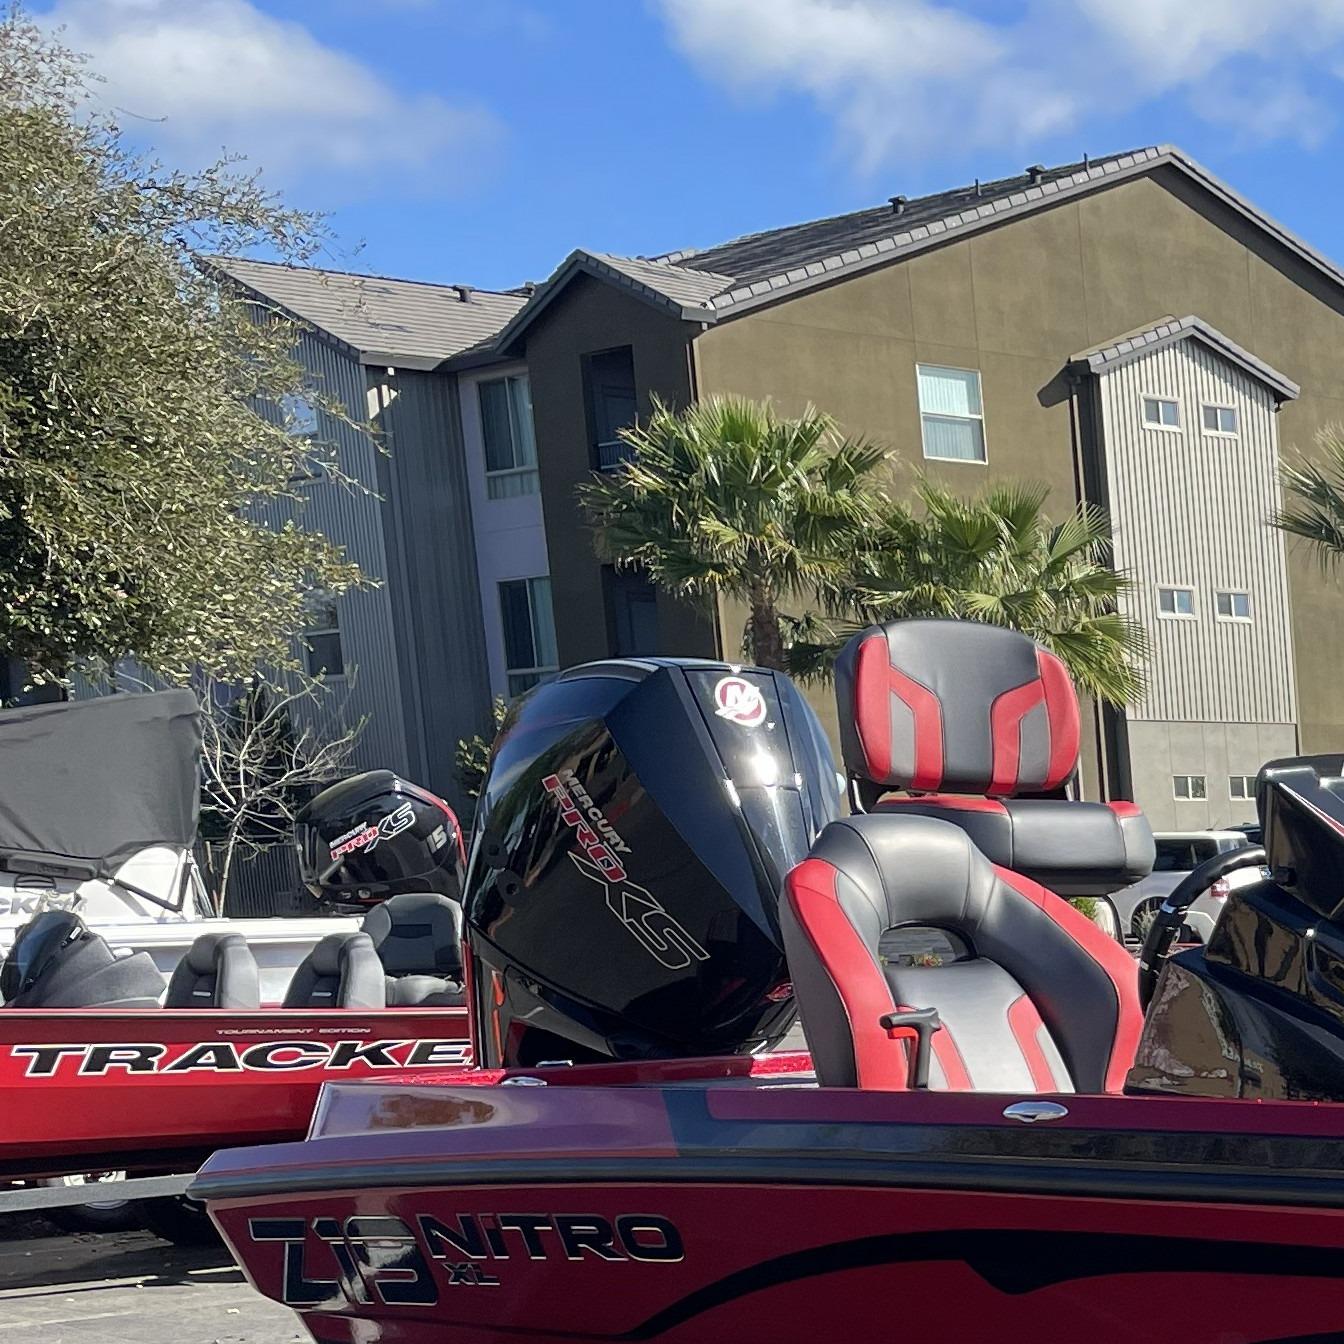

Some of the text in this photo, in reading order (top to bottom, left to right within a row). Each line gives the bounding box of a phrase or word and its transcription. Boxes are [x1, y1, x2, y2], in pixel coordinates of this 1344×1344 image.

[330, 826, 380, 861] PRO
[364, 801, 416, 854] XS
[560, 768, 632, 854] MERCURY
[542, 774, 711, 970] PRO XS
[216, 1028, 313, 1036] TOURNAMENT
[10, 1039, 474, 1078] TRACKE
[443, 1262, 501, 1286] XL
